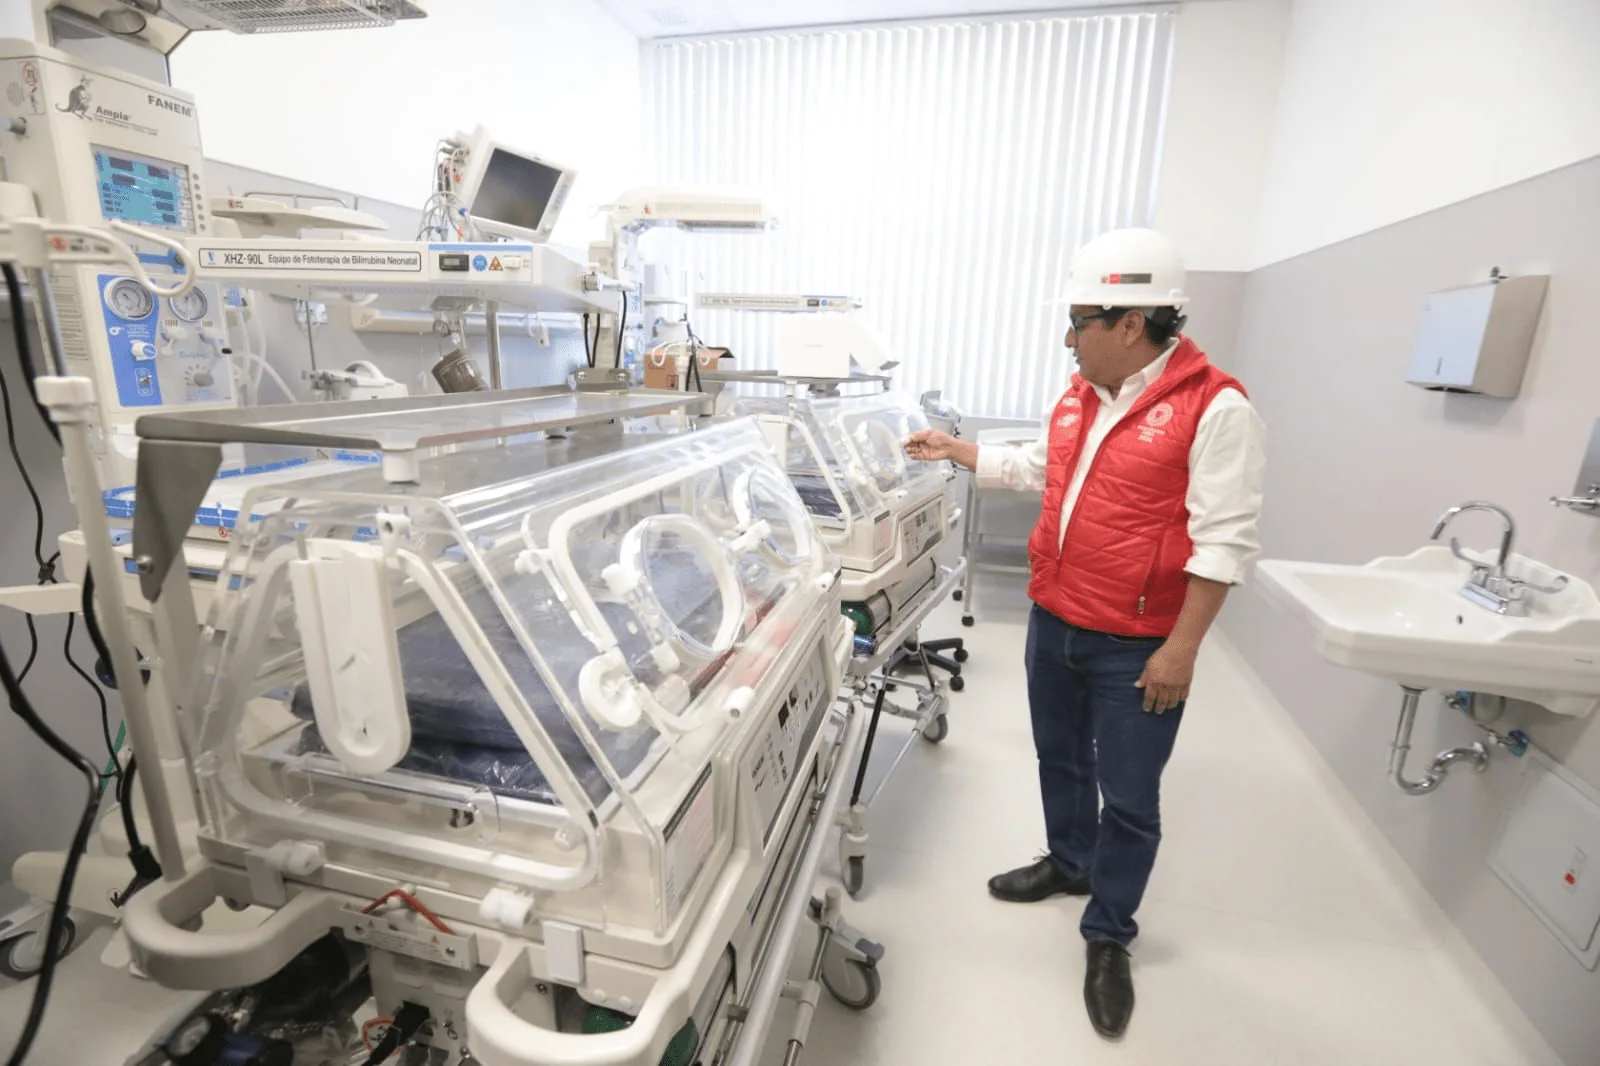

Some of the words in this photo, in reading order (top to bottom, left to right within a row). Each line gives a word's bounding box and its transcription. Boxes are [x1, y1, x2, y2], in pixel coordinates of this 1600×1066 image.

[148, 94, 192, 118] FANEM
[224, 253, 264, 265] XHZ-90L
[268, 254, 291, 265] Equipo
[292, 255, 301, 263] de
[303, 255, 340, 265] Fototerapia
[342, 256, 350, 264] de
[387, 256, 418, 266] Neonatal
